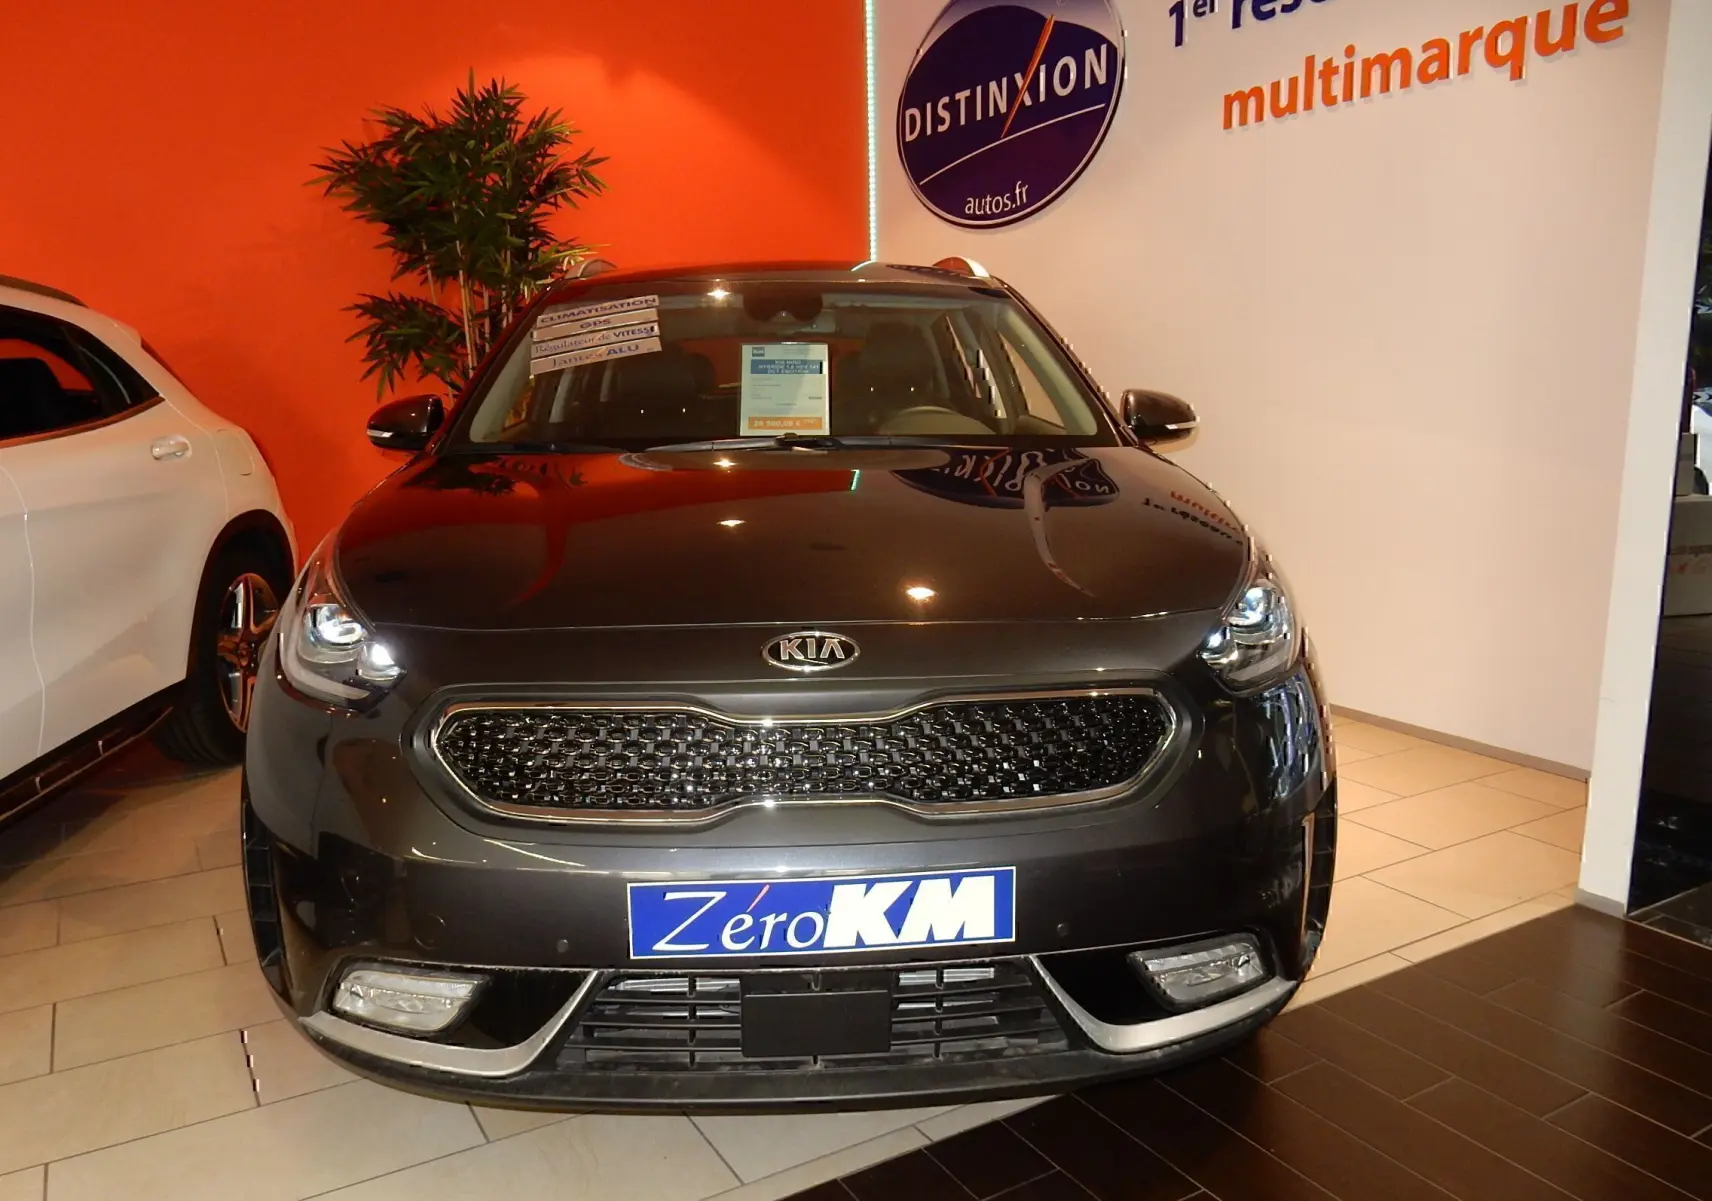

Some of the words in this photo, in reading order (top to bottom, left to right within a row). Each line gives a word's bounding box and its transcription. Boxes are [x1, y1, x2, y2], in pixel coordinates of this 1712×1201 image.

[1223, 0, 1628, 130] multimarque
[904, 43, 1108, 142] DISTINXION
[964, 181, 1029, 215] autos.fr
[540, 298, 657, 323] CLIMATISATION
[579, 318, 612, 329] GPS
[606, 344, 640, 357] ALU
[780, 639, 845, 660] KIA
